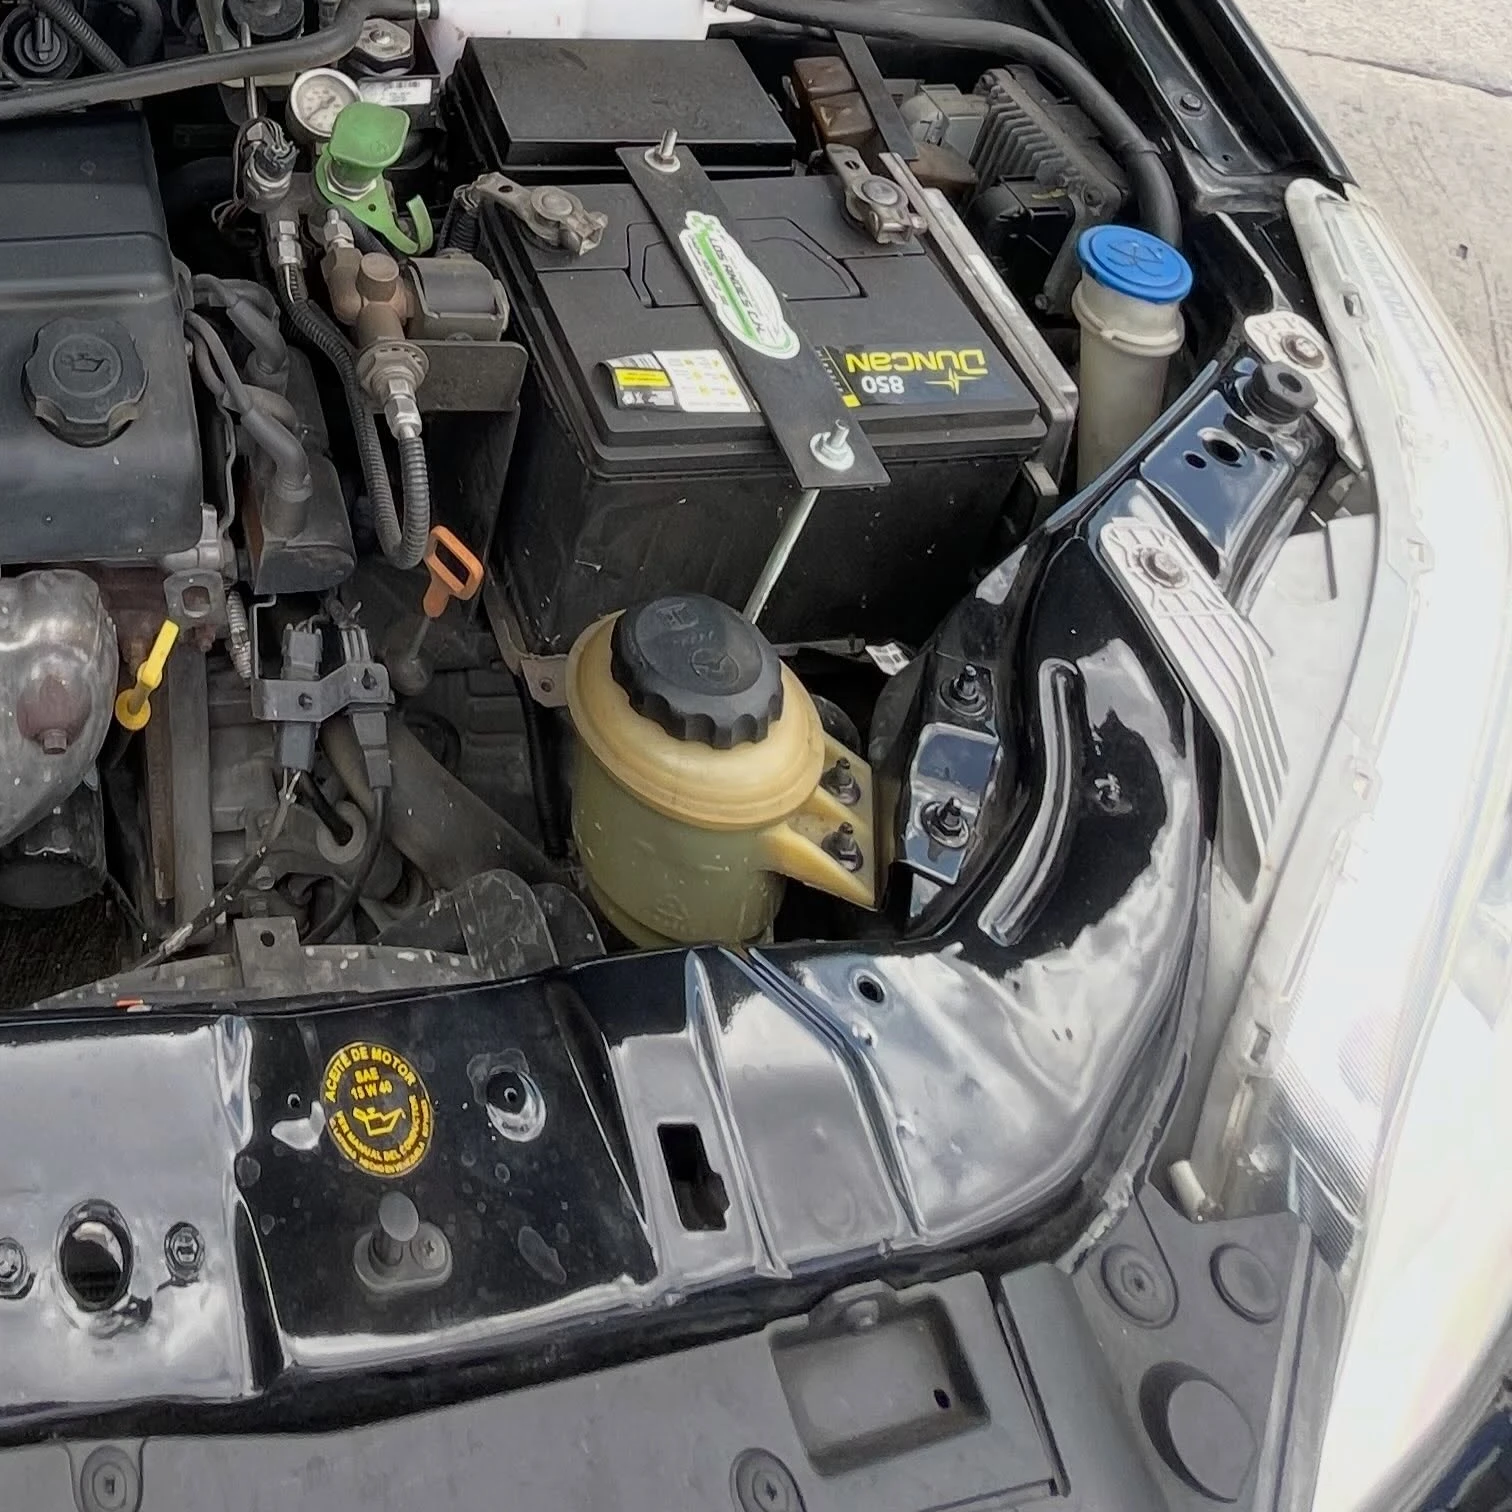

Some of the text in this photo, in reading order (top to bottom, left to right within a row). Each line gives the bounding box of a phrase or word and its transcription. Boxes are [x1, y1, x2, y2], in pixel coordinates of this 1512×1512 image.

[861, 375, 905, 395] 850
[324, 1046, 417, 1103] ACEITE DE MOTOR
